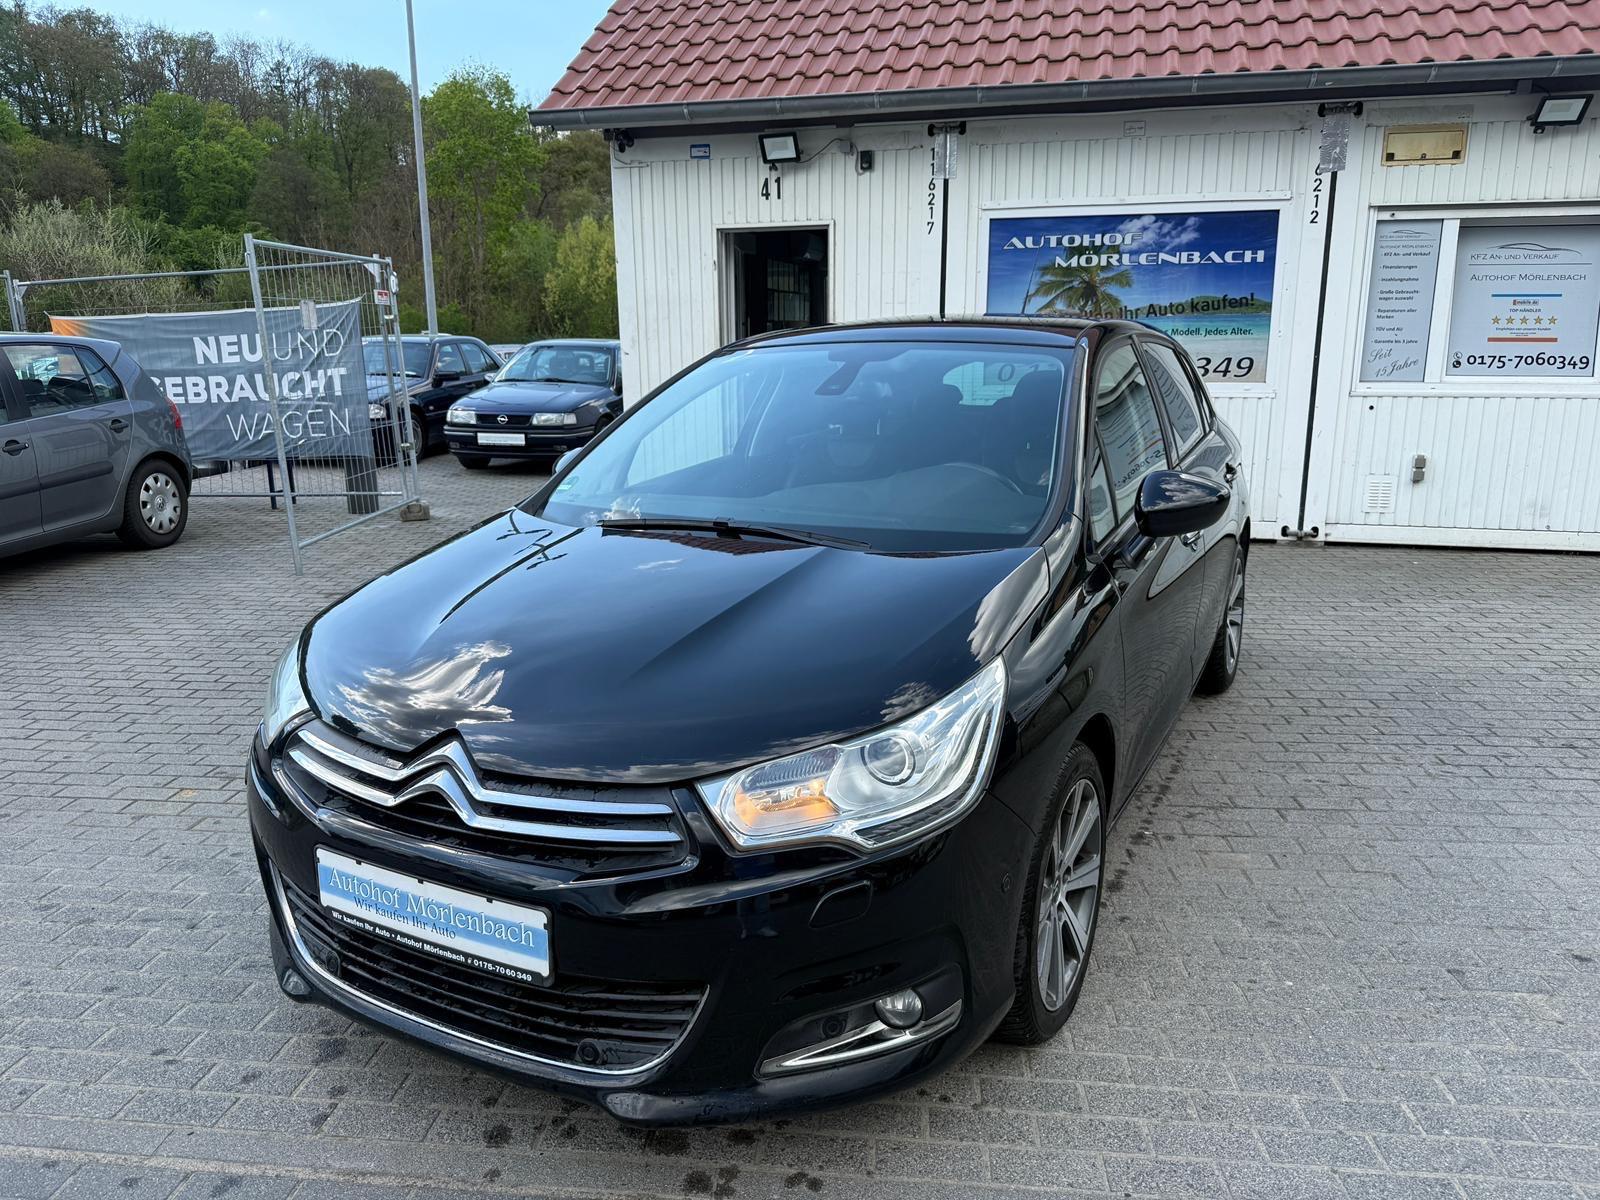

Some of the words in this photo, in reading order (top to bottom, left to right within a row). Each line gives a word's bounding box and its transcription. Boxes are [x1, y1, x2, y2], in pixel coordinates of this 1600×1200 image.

[761, 176, 781, 201] 41
[1002, 231, 1145, 250] AUTOHOF
[1054, 248, 1265, 268] MÖRLENBACH
[1470, 253, 1488, 261] KFZ
[1469, 273, 1518, 281] AUTOHOF
[1518, 273, 1587, 281] MÖRLENBACH
[1119, 305, 1141, 319] Ihr
[1145, 302, 1185, 317] Auto
[1190, 292, 1255, 313] kaufen!
[1170, 328, 1203, 336] Modell.
[1204, 327, 1228, 338] Jedes
[1229, 327, 1254, 336] Alter.
[192, 333, 263, 365] NEU
[272, 329, 344, 360] UND
[1466, 352, 1590, 370] 0175-7060349
[151, 367, 348, 404] EBRAUCHT
[226, 408, 350, 441] WAGEN
[329, 867, 401, 909] Autohof
[406, 893, 535, 948] Mörlenbach
[353, 896, 373, 912] Wir
[375, 903, 410, 925] kaufen
[412, 916, 428, 930] Ihr
[430, 922, 456, 940] Auto
[332, 910, 343, 920] Wir
[343, 914, 364, 928] kaufen
[364, 922, 374, 932] Ihr
[375, 926, 391, 938] Auto
[396, 934, 423, 950] Autohof
[423, 943, 466, 963] Mörlenbach
